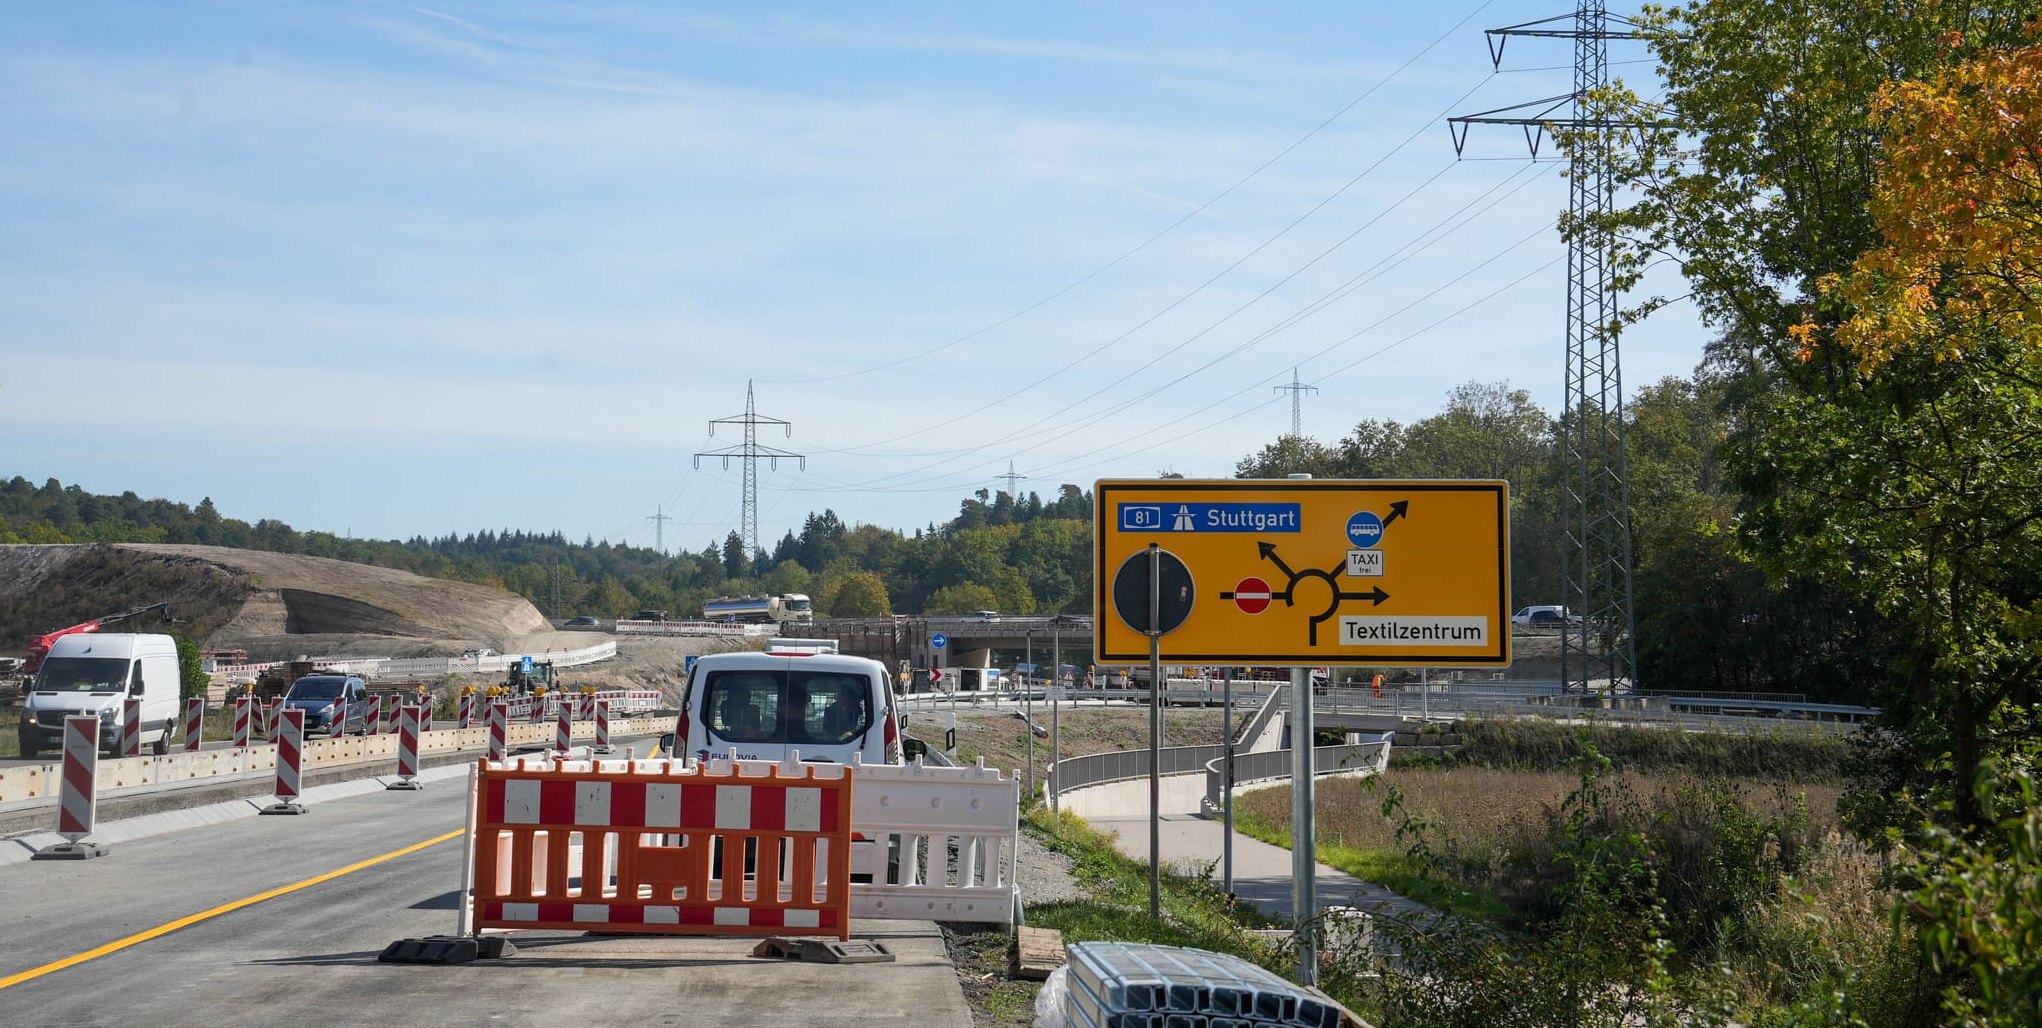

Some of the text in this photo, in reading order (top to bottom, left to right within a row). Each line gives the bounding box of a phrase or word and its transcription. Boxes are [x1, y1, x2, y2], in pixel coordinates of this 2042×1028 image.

[1135, 509, 1295, 531] 81 Stuttgart
[1351, 554, 1378, 565] TAXI
[1345, 621, 1481, 640] Textilzentrum
